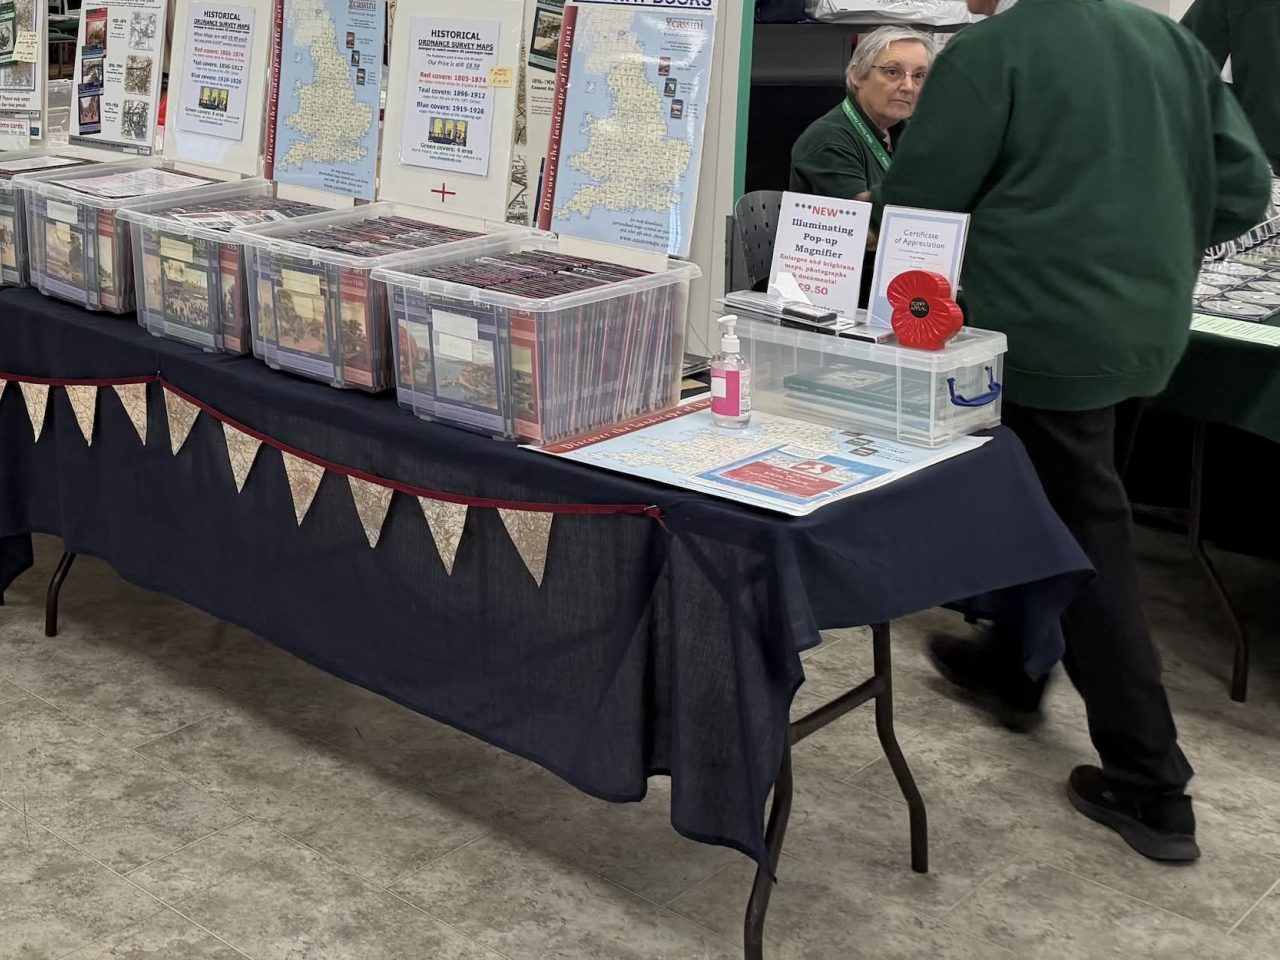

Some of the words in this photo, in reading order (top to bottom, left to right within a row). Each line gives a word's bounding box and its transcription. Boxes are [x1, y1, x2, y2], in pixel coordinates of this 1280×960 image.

[353, 1, 376, 10] cassini
[204, 11, 240, 20] HISTORICAL
[431, 29, 481, 40] HISTORICAL
[564, 25, 573, 48] past
[418, 39, 450, 48] ORDNANCE
[451, 41, 475, 50] SURVEY
[477, 43, 494, 51] MAPS
[561, 52, 569, 69] the
[433, 73, 452, 81] covers:
[454, 75, 486, 83] 1805-1874
[454, 90, 485, 99] 1896-1912
[430, 103, 451, 111] covers:
[452, 105, 484, 115] 1919-1926
[554, 88, 566, 140] landscape
[543, 165, 556, 211] Discover
[792, 218, 854, 236] Illuminating
[803, 232, 838, 246] Pop-up
[903, 229, 939, 240] Certificate
[794, 244, 843, 259] Magnifier
[903, 239, 945, 250] Appreciation
[780, 254, 808, 263] Enlarges
[823, 261, 855, 271] brightens
[785, 263, 804, 271] maps,
[805, 266, 847, 278] photographs
[798, 282, 828, 296] £9.50
[560, 433, 611, 449] Discover
[613, 426, 632, 435] the
[633, 411, 682, 428] landscape
